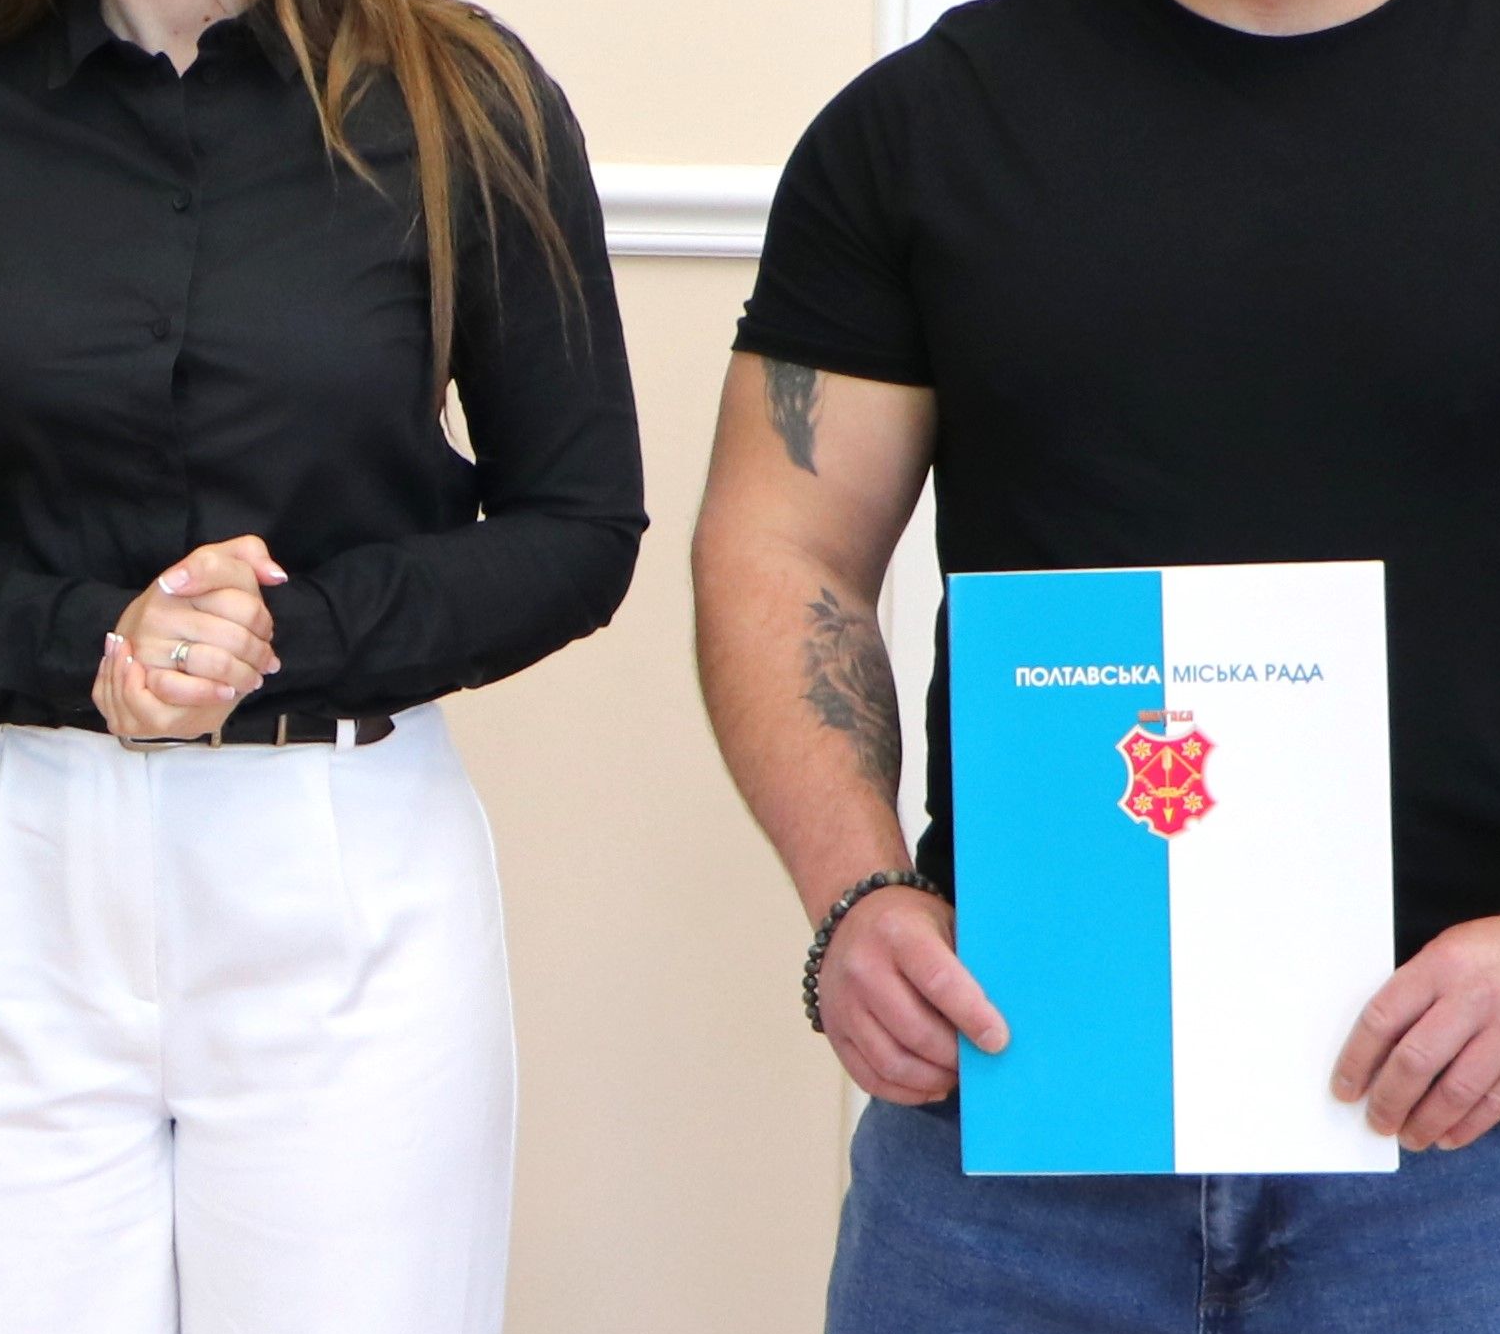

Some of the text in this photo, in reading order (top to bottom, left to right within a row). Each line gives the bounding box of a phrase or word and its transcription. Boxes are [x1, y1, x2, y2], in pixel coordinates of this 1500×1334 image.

[1015, 663, 1324, 687] ПОЛТАВСЬКА МІСЬКА РАДА
